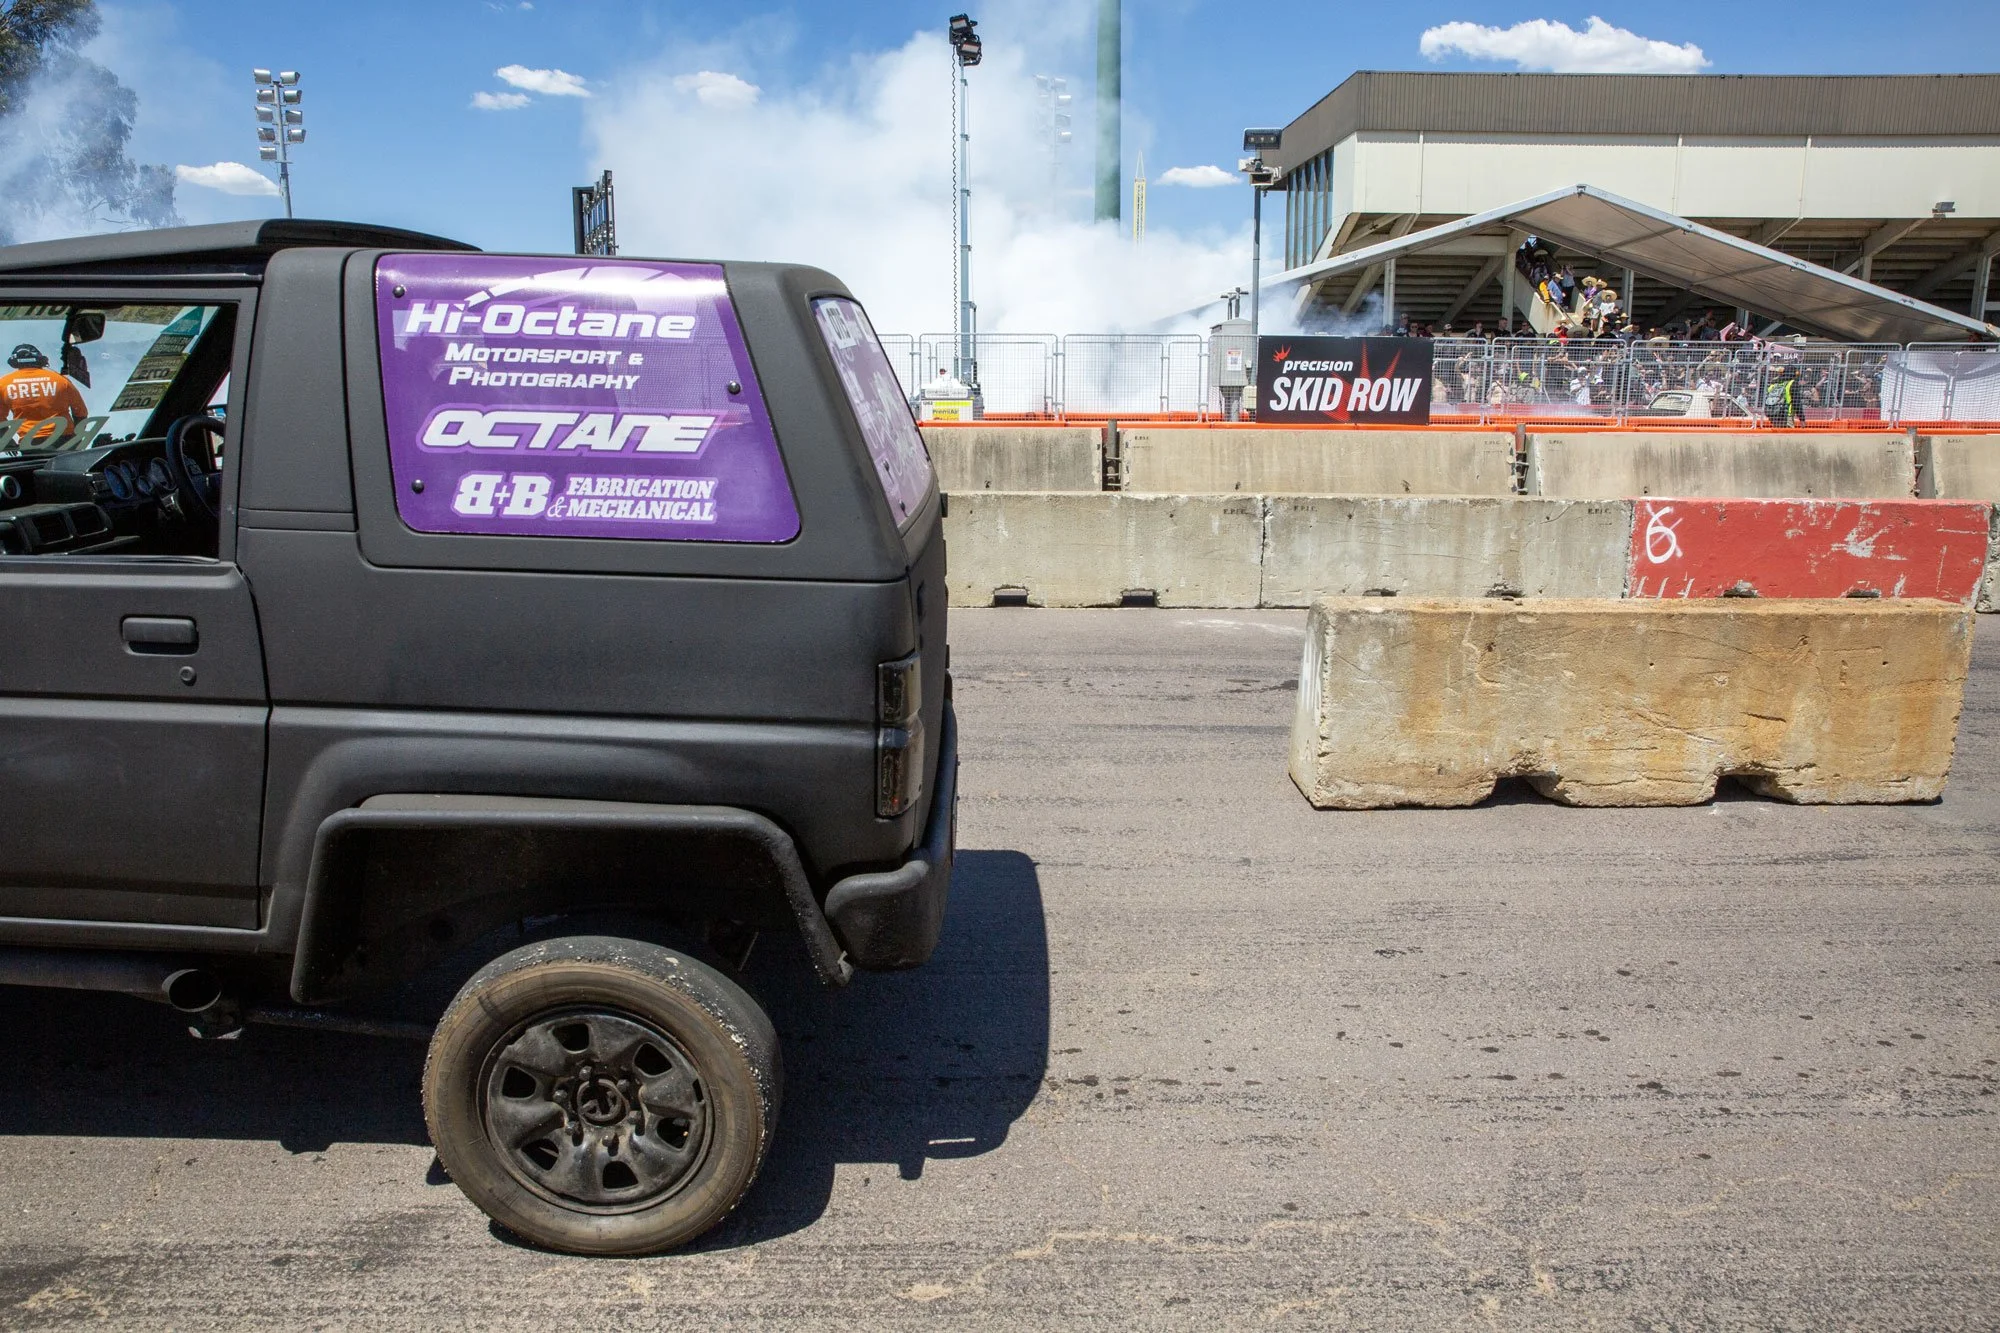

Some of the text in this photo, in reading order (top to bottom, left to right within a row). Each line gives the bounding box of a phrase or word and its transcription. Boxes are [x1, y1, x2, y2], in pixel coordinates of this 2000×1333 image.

[405, 302, 696, 339] Hi-Octane
[445, 343, 644, 366] MOTORSPORT &
[1282, 360, 1354, 374] precision
[449, 366, 641, 390] PHOTOGRAPHY
[7, 382, 58, 400] CREW
[1269, 377, 1422, 412] SKID ROW
[422, 409, 717, 453] OCTANE
[453, 473, 552, 516] B+B
[566, 476, 715, 498] FABRICATION
[547, 496, 716, 521] & MECHANICAL
[1646, 506, 1677, 564] 6
